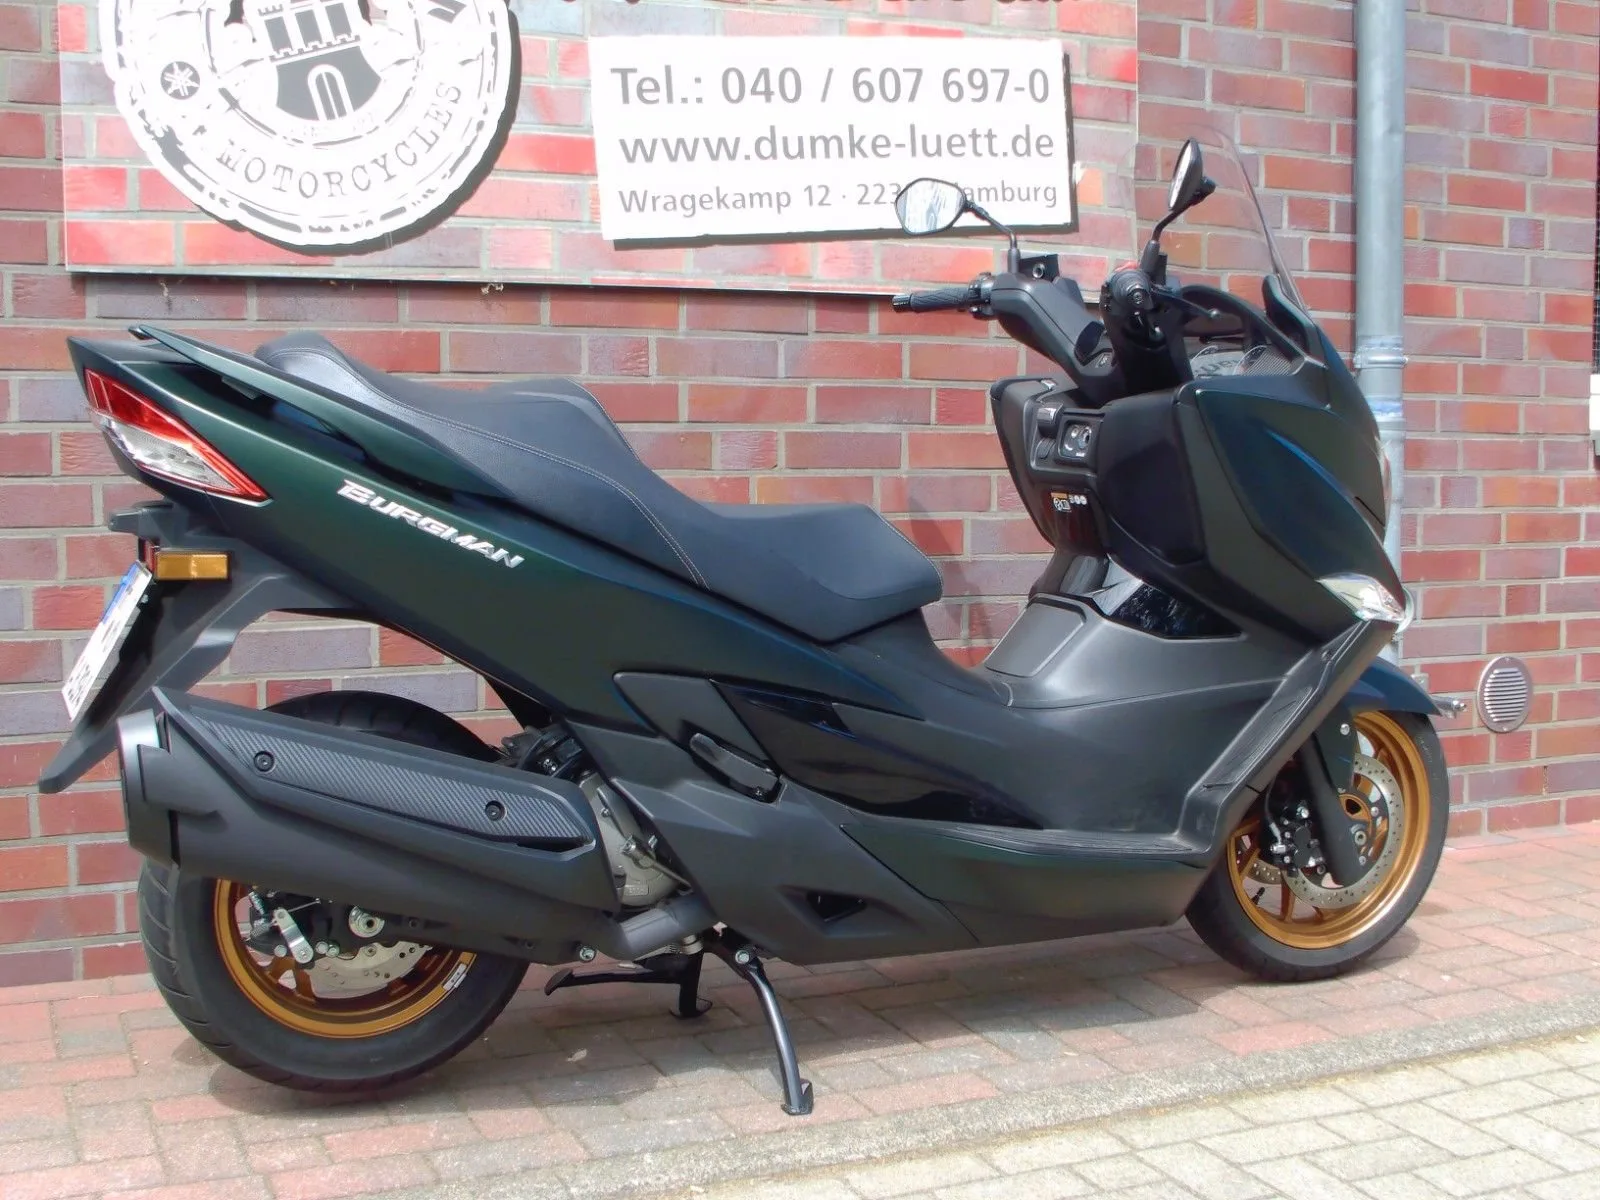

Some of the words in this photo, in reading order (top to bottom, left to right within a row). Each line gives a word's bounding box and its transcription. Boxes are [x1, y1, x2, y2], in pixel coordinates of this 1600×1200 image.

[610, 65, 703, 105] Tel.:
[721, 66, 803, 104] 040
[820, 67, 834, 103] /
[852, 67, 924, 104] 607
[942, 68, 1050, 104] 697-0
[215, 81, 462, 200] MOTORCYCLES
[619, 123, 1054, 164] www.dumke-luett.de
[618, 184, 792, 219] Wragekamp
[804, 184, 832, 207] 12
[953, 179, 1057, 209] amburg
[337, 479, 525, 568] BURGMAN
